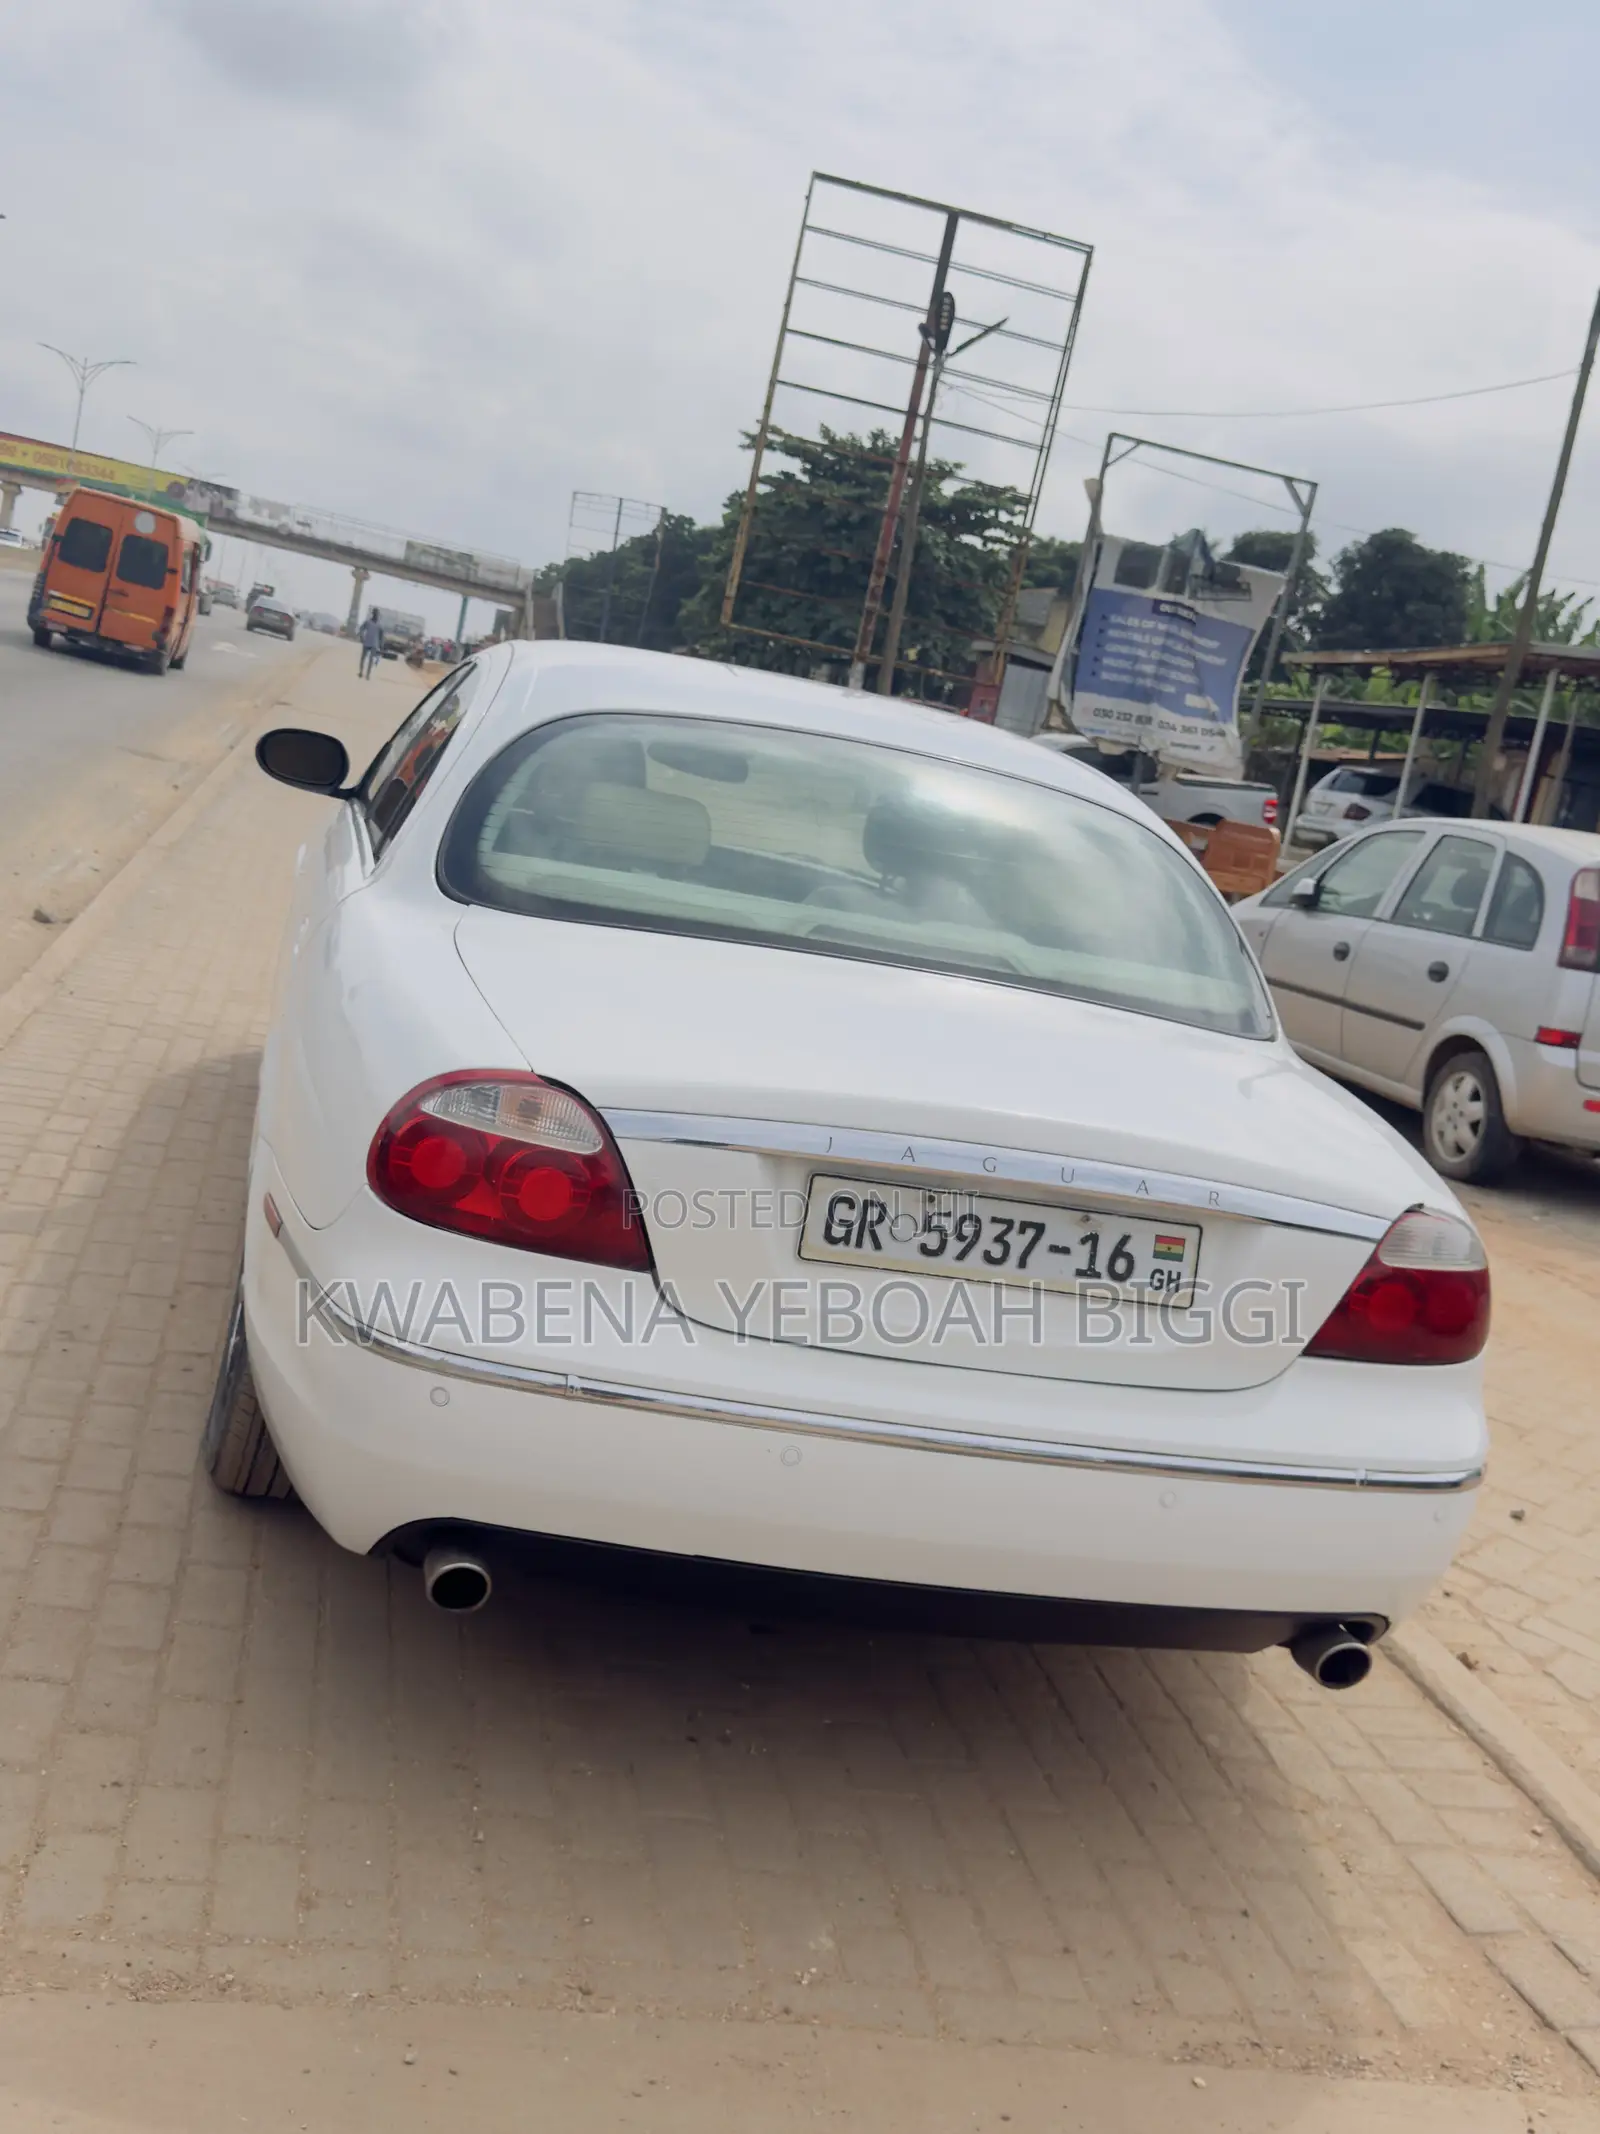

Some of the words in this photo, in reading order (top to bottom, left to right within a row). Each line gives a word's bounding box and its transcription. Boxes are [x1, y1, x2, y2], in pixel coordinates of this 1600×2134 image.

[825, 1136, 1220, 1207] JAGUAR
[824, 1195, 887, 1250] GR
[918, 1209, 1135, 1282] 5937-16
[1150, 1268, 1181, 1293] GH
